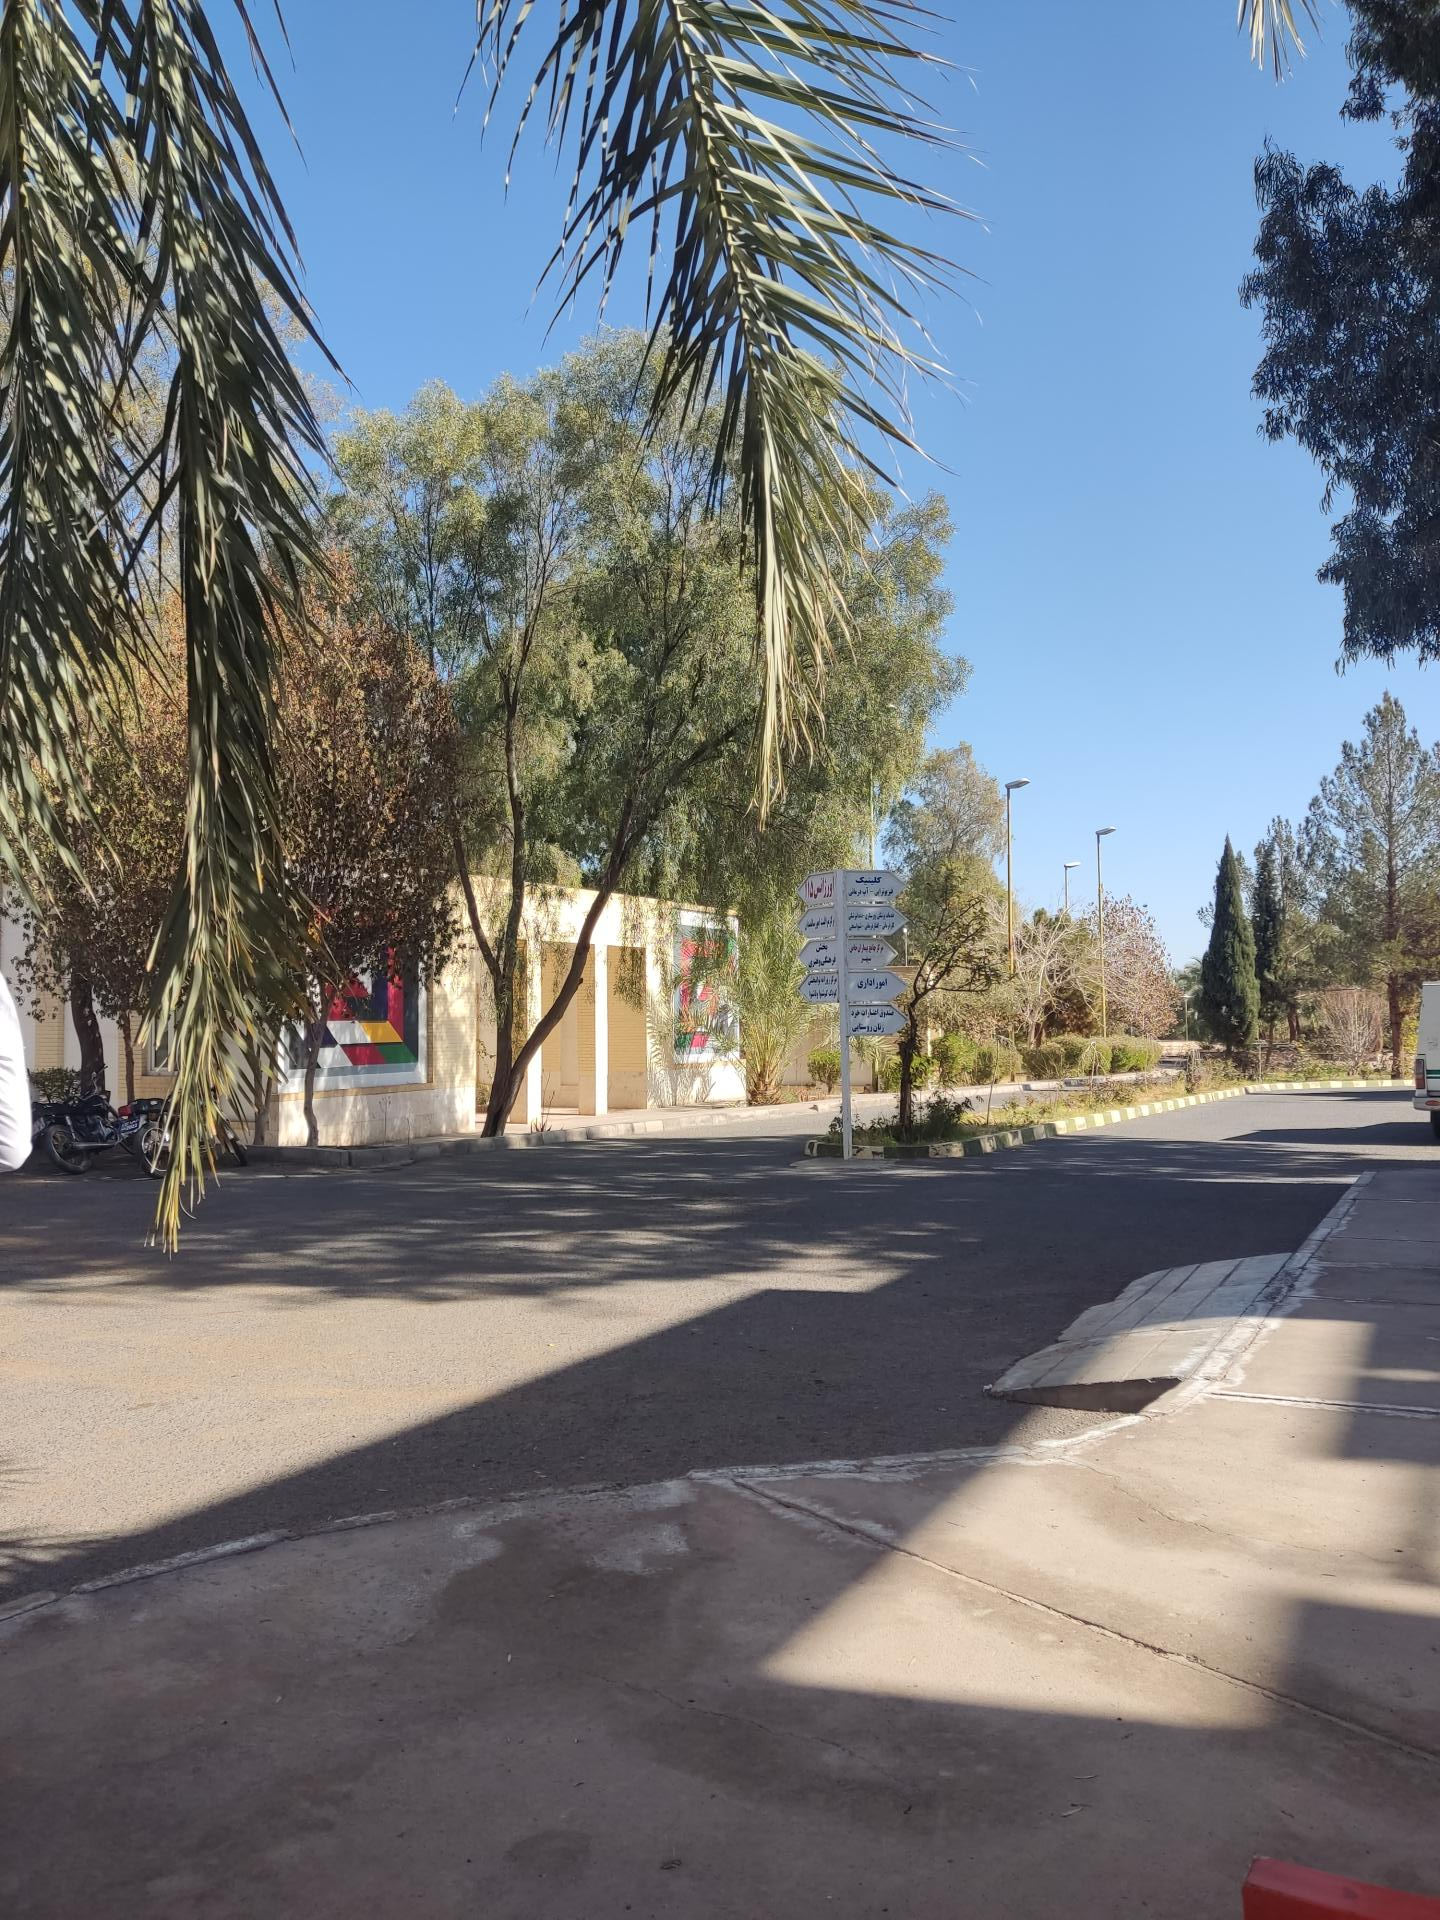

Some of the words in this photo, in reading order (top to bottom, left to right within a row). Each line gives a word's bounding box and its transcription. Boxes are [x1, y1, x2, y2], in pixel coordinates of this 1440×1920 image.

[856, 876, 882, 886] کلینیک
[814, 876, 834, 898] اورژانس
[816, 943, 828, 952] بخش
[857, 978, 875, 989] اداری
[875, 978, 888, 989] امور
